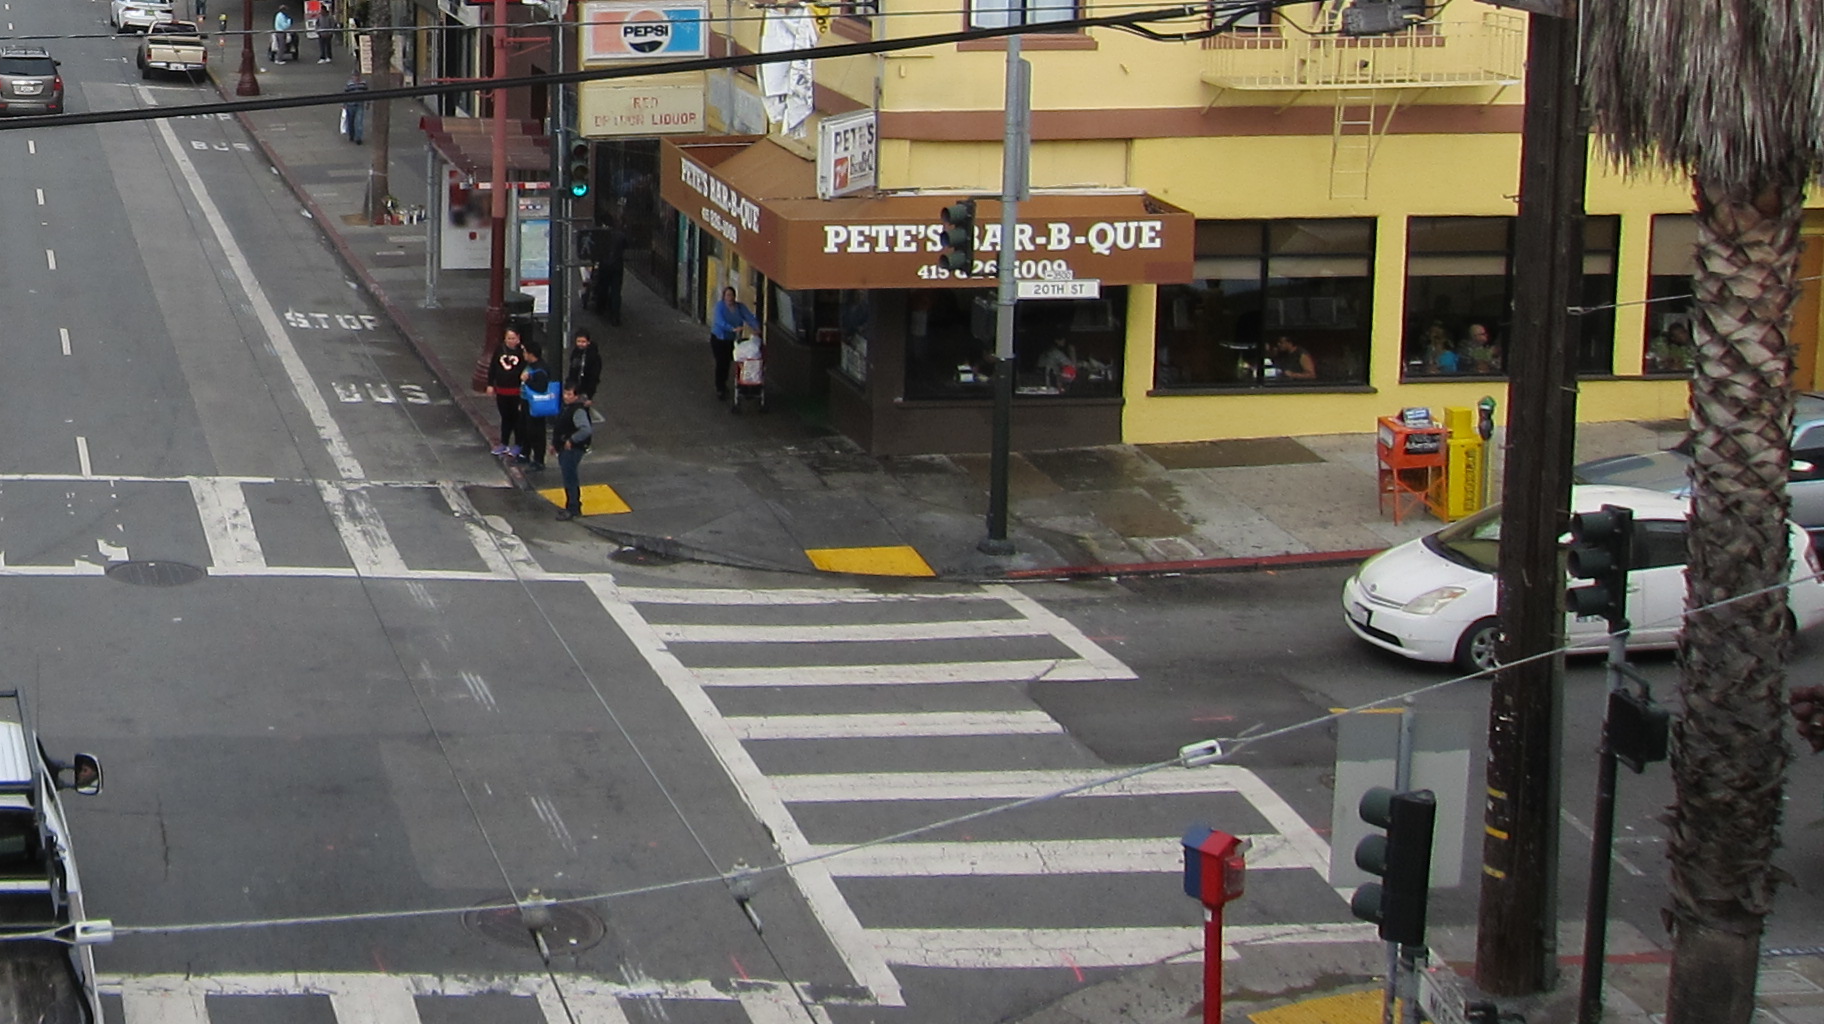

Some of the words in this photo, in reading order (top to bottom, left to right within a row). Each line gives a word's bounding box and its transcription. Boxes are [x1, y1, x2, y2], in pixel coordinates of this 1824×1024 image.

[623, 25, 669, 37] PEPSI
[834, 123, 874, 153] PETE'S
[680, 157, 708, 198] PETE'S
[709, 174, 761, 234] BAR-B-QUE
[823, 224, 944, 254] PETE'S
[917, 263, 950, 279] 415
[1034, 284, 1064, 295] 20TH
[1071, 284, 1085, 294] ST
[284, 312, 380, 331] STOP
[331, 381, 431, 404] BUS
